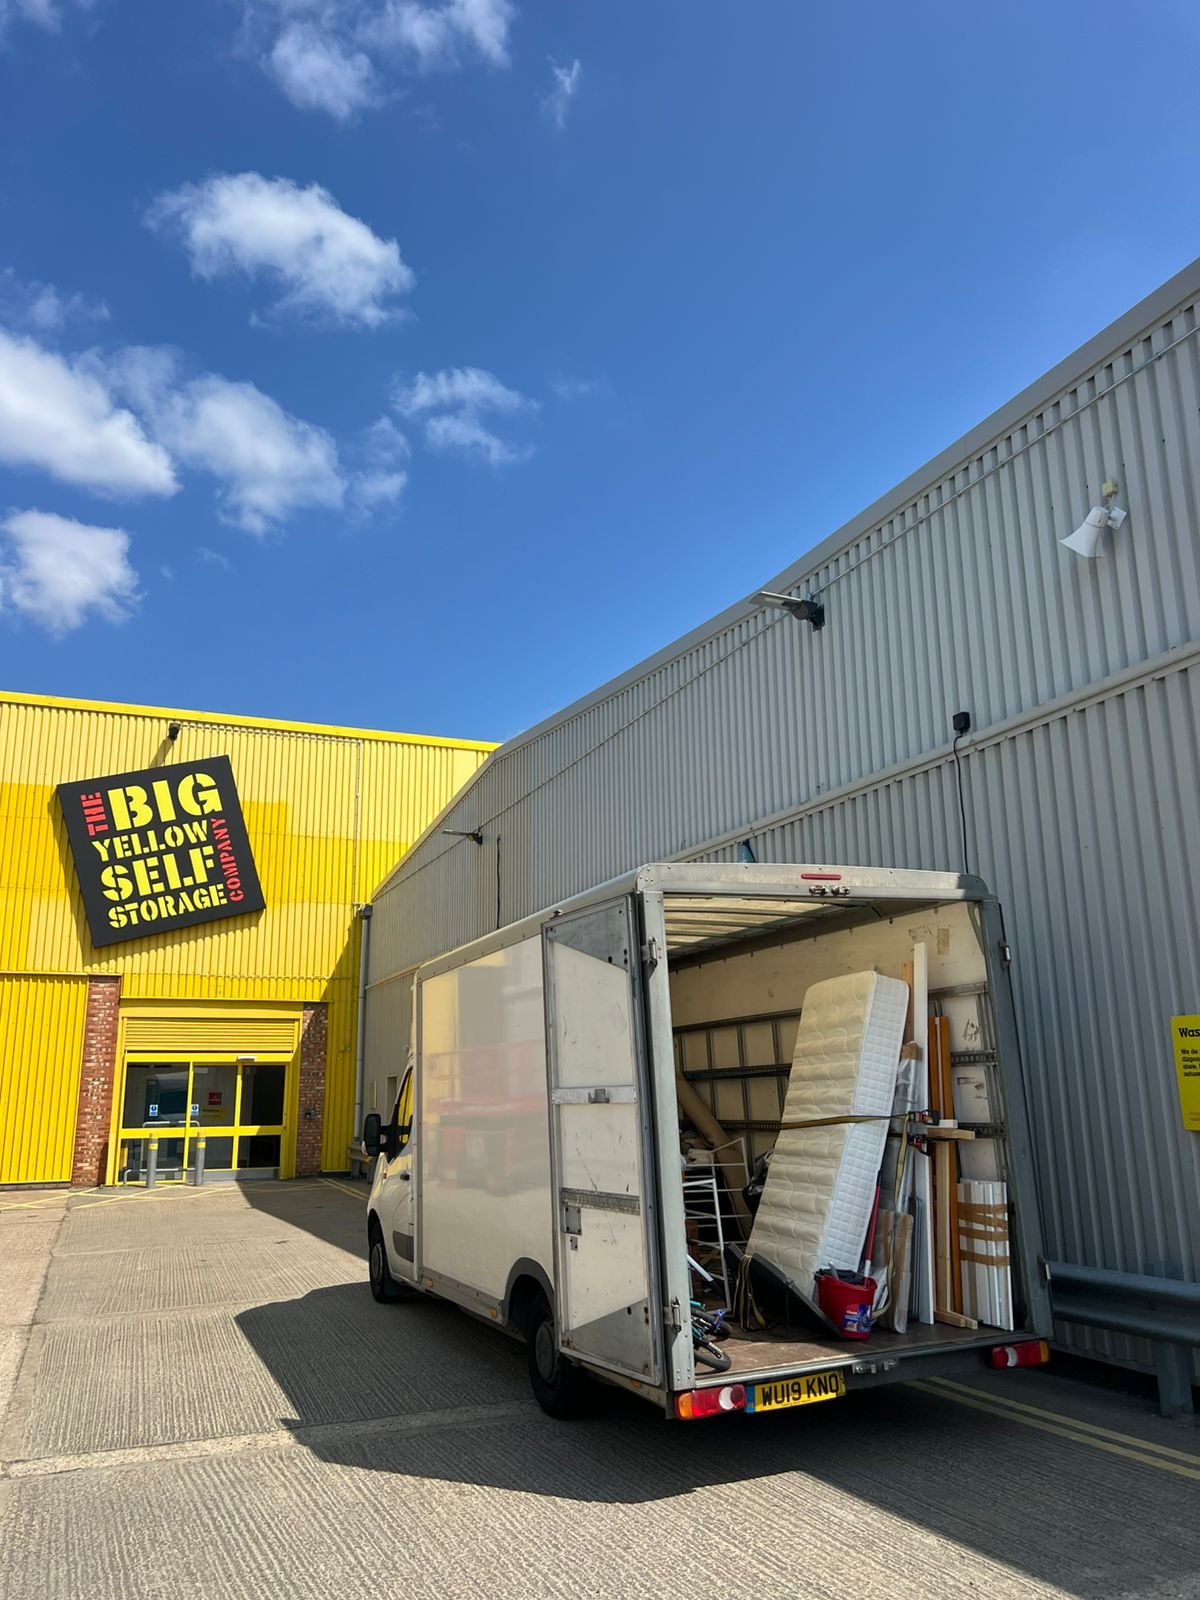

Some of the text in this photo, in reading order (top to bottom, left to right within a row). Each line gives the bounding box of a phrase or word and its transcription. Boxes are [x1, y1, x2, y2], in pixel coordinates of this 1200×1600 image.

[80, 792, 109, 836] THE
[108, 773, 223, 831] BIG
[92, 820, 208, 862] YELLOW
[210, 817, 245, 902] COMPANY
[101, 845, 215, 901] SELF
[108, 883, 228, 929] STORAGE
[762, 1373, 840, 1406] WU19 KNO
